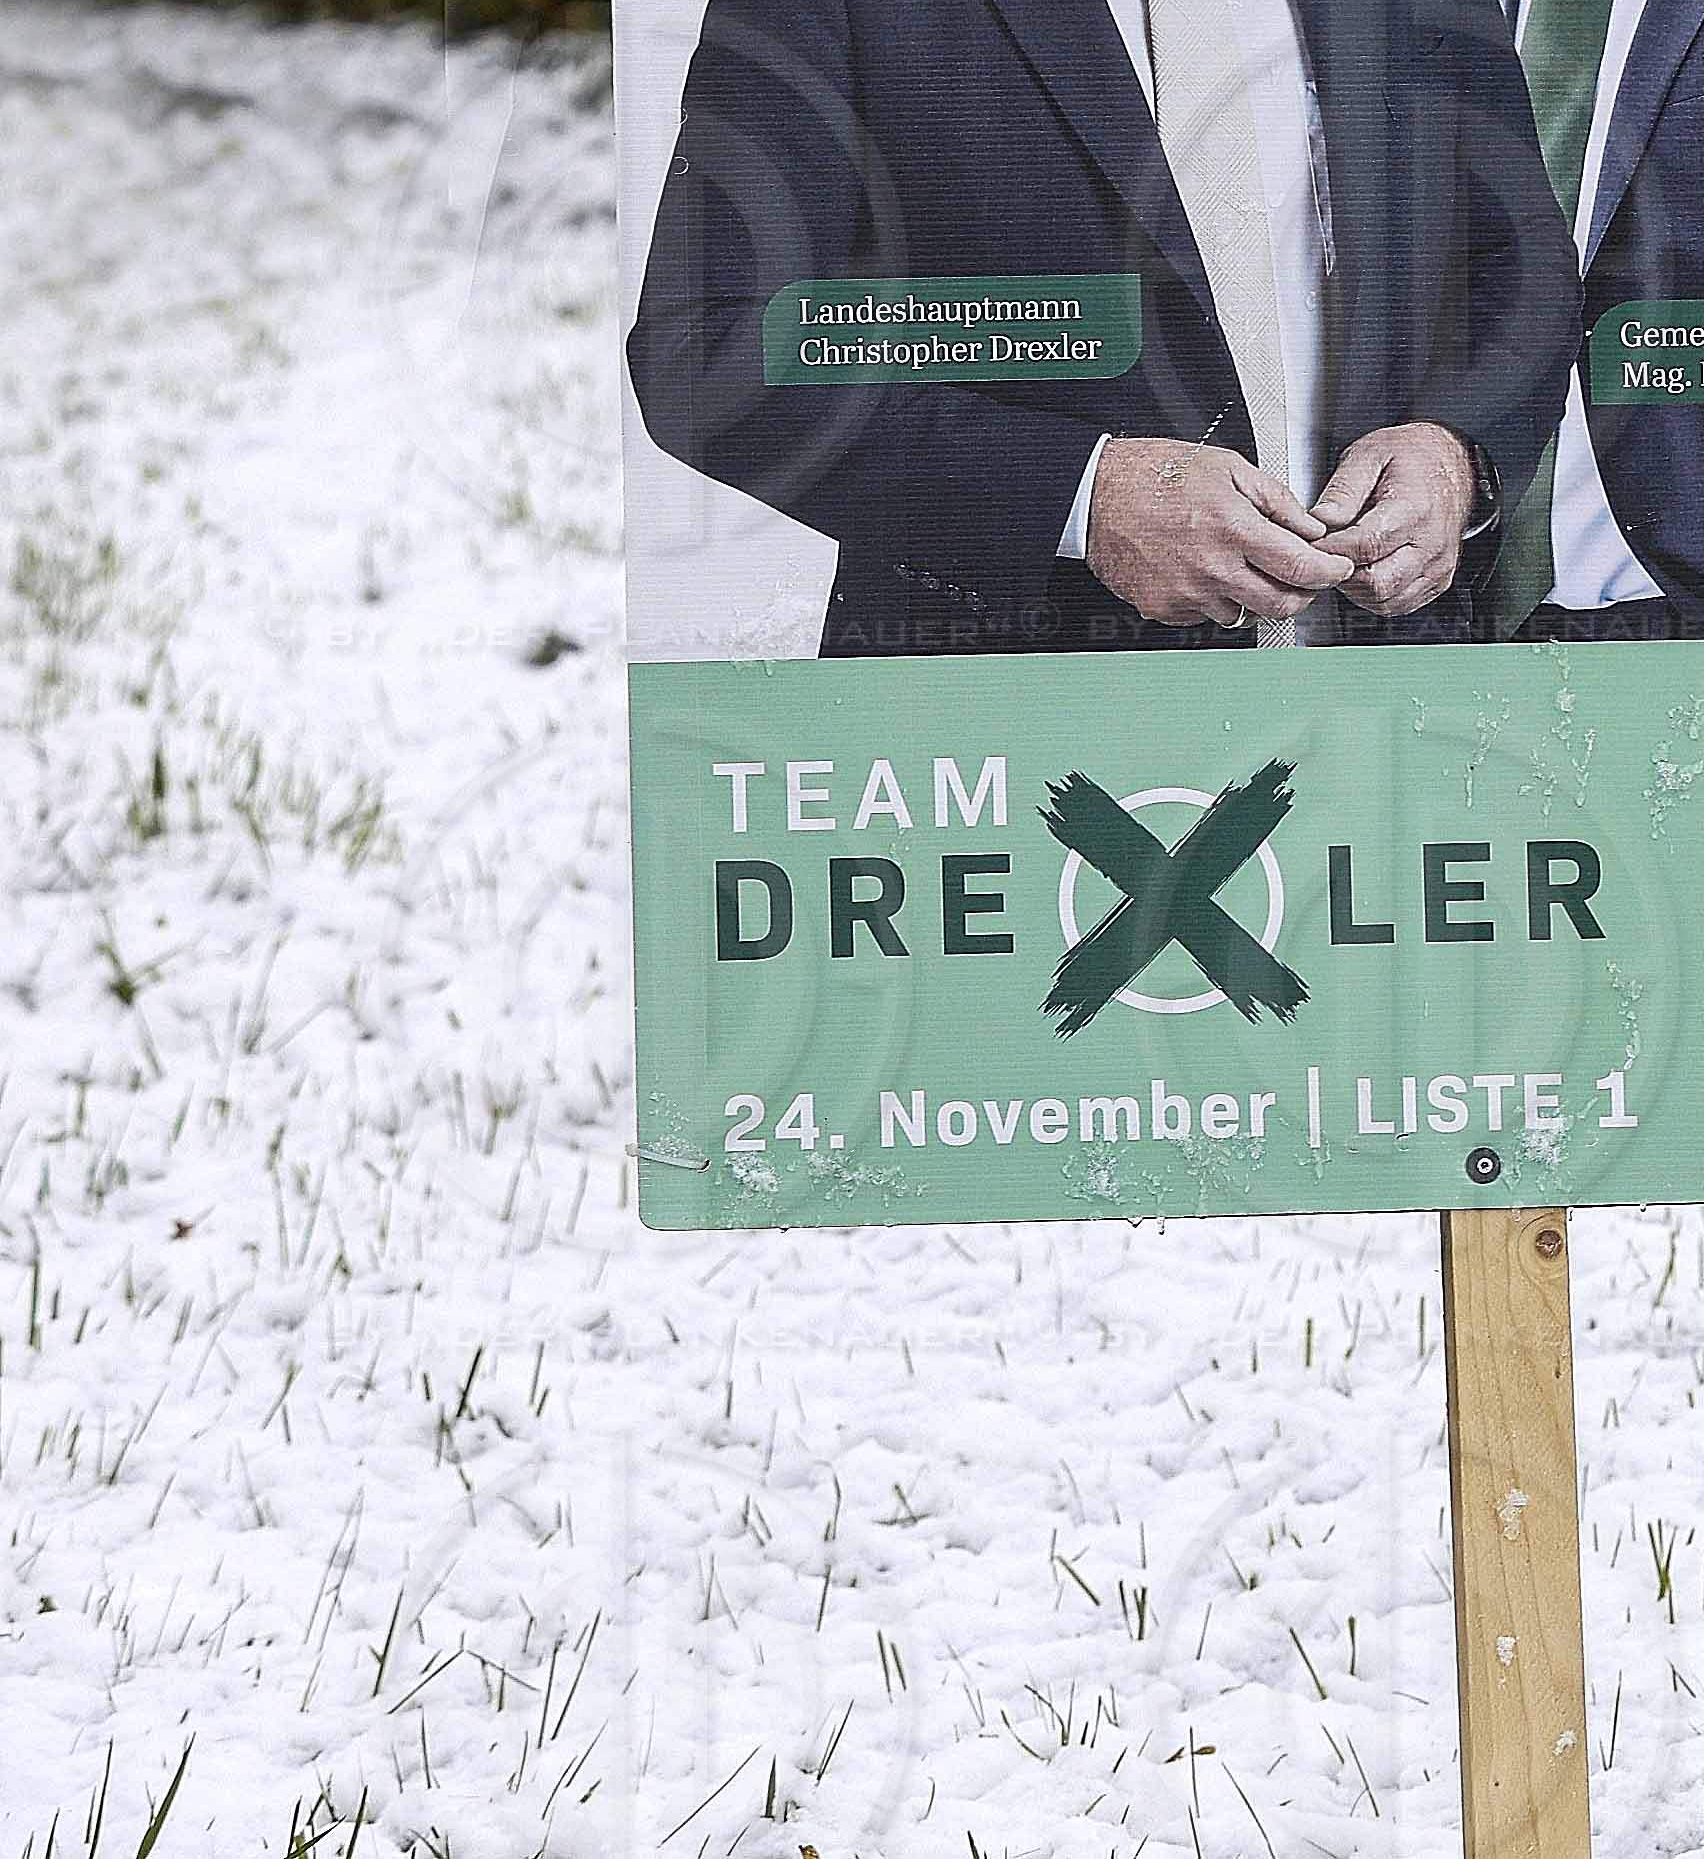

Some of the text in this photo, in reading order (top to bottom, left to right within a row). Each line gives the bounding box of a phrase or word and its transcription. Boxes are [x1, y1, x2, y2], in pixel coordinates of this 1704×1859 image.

[799, 295, 1083, 328] Landeshauptmann
[799, 332, 1103, 370] Christopher Drexler
[1622, 360, 1693, 394] Mag.
[712, 755, 1009, 834] TEAM
[714, 756, 1609, 1043] DREXLER
[723, 1091, 847, 1152] 24.
[879, 1078, 1277, 1148] November
[1354, 1072, 1565, 1136] LISTE
[1595, 1069, 1640, 1129] 1
